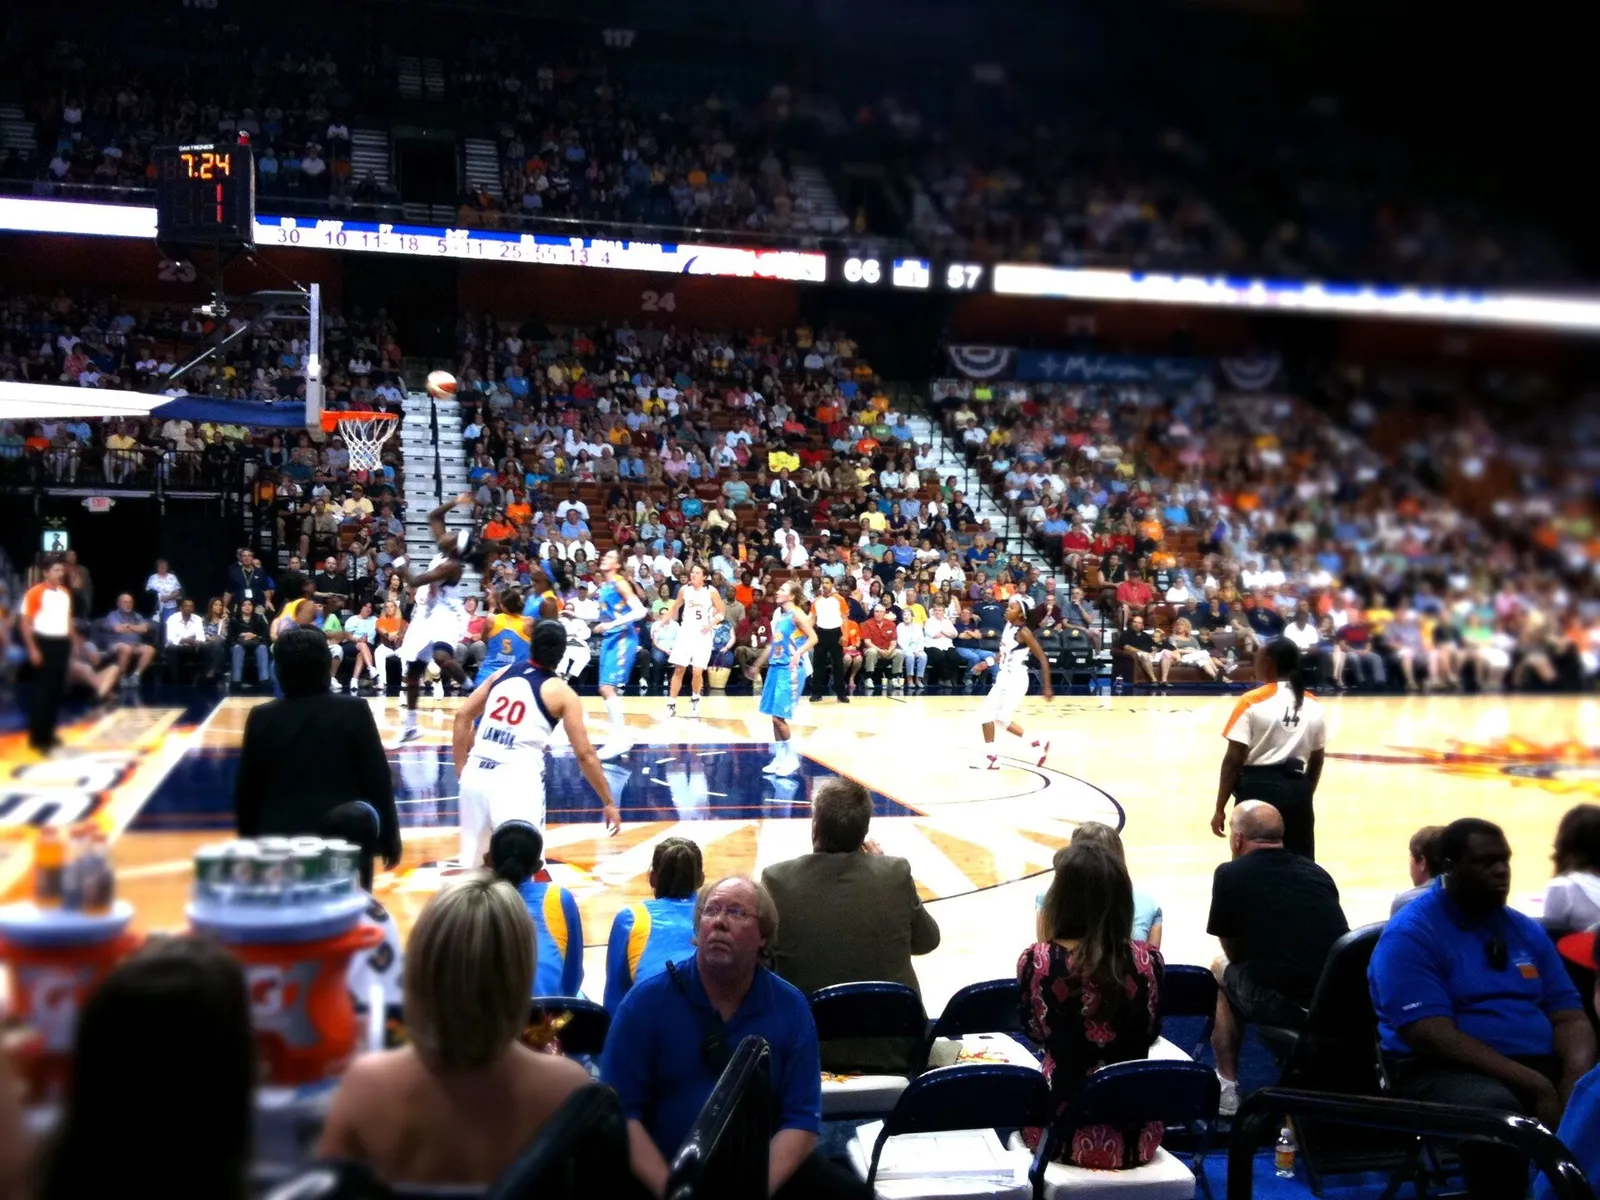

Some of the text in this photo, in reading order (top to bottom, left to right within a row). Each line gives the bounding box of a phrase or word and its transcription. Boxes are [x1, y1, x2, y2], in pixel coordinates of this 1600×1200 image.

[601, 28, 636, 48] 117
[277, 228, 301, 244] 30
[324, 230, 347, 247] 10
[157, 259, 196, 282] 23
[843, 257, 881, 284] 66
[947, 264, 982, 289] 57
[641, 290, 676, 312] 24
[695, 610, 703, 620] 5
[502, 638, 513, 655] 5
[489, 696, 526, 726] 20
[1282, 706, 1301, 728] 44
